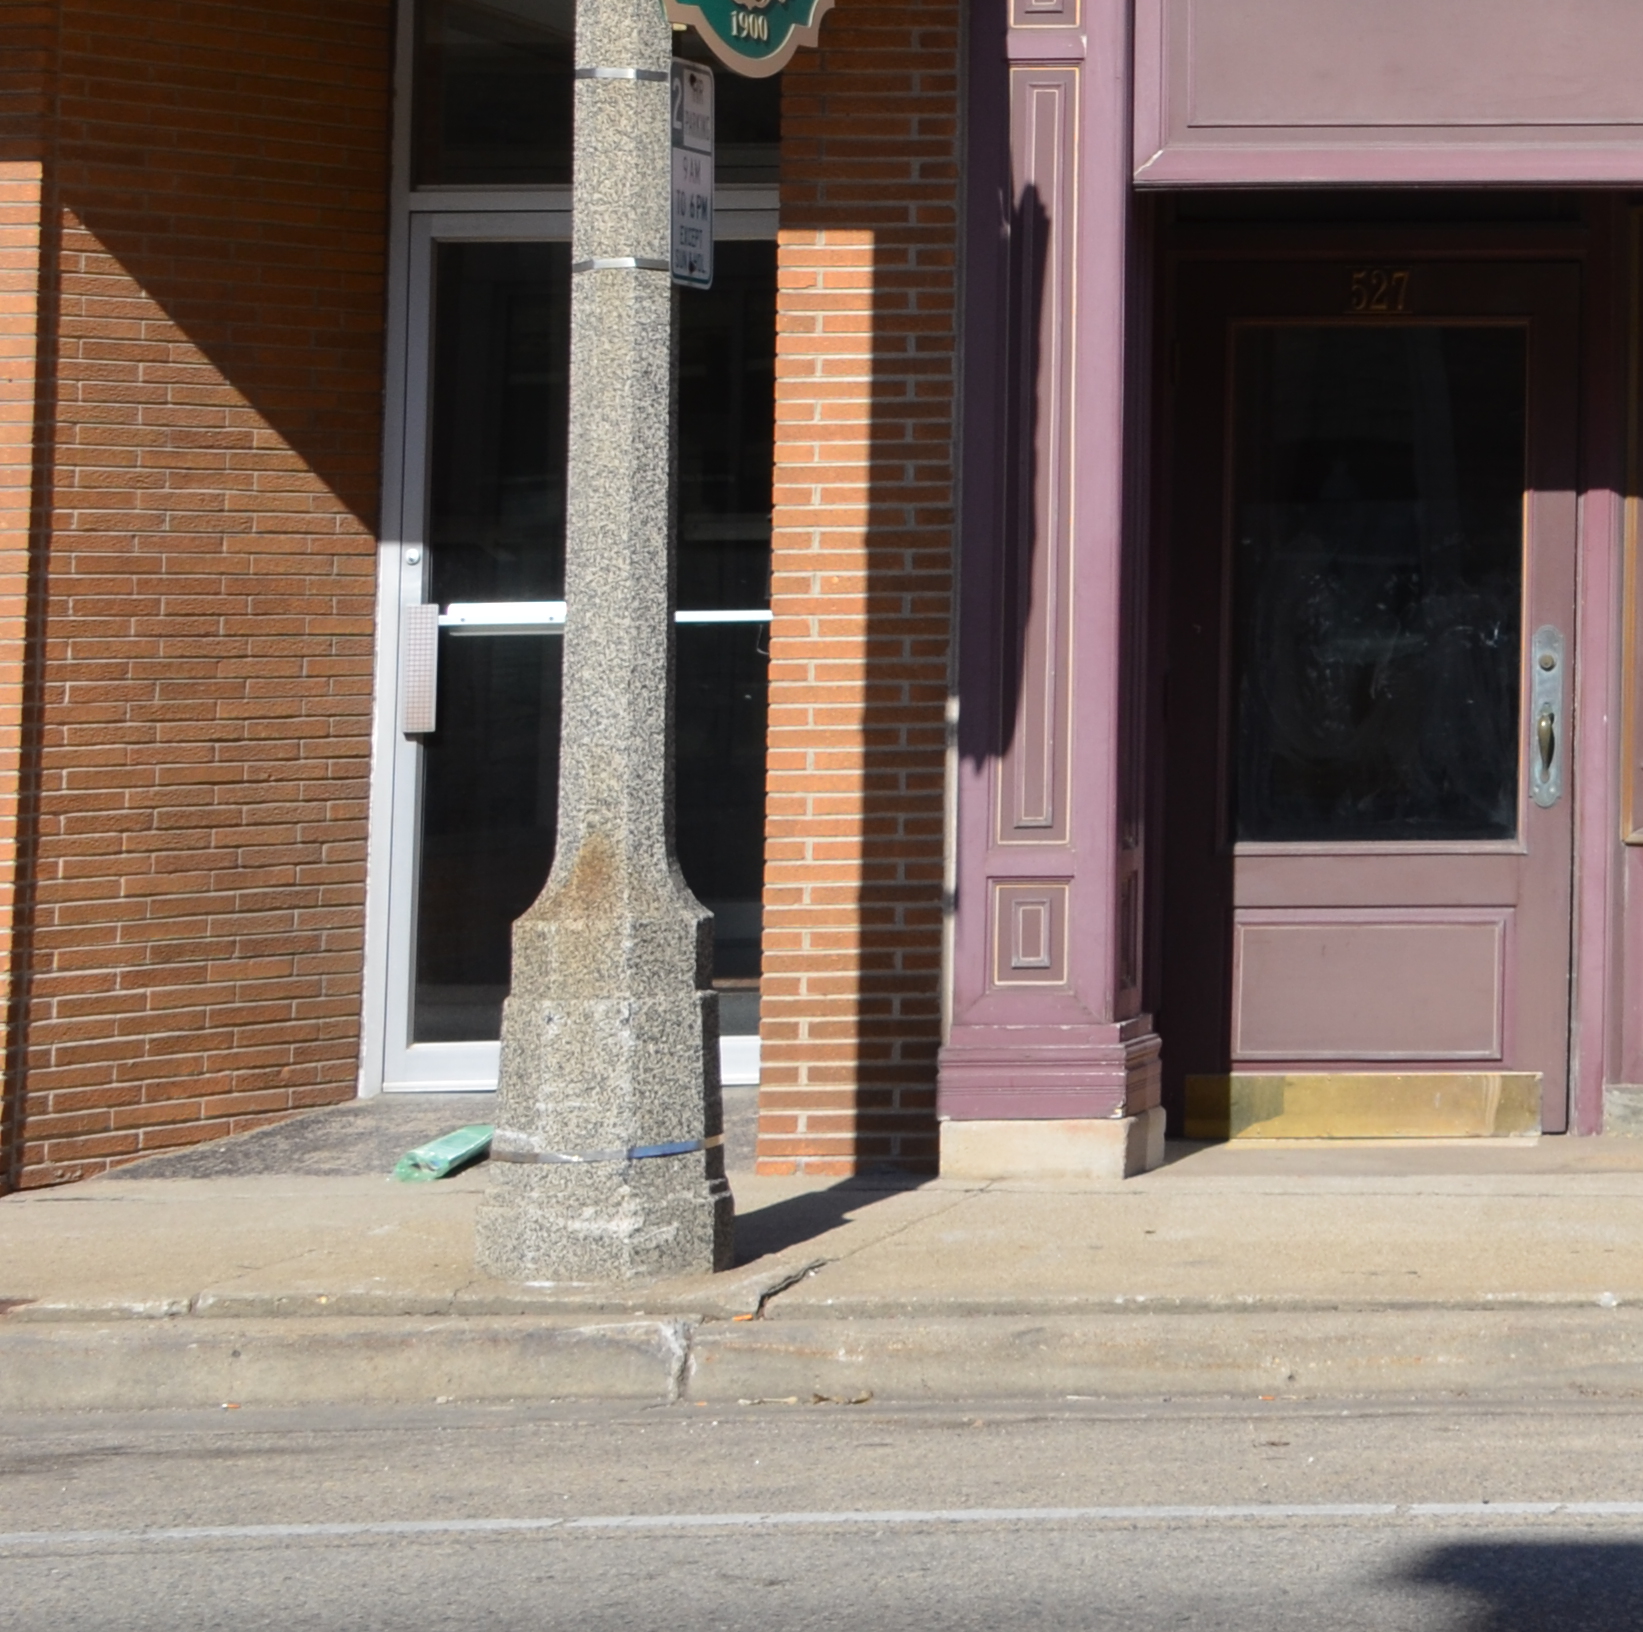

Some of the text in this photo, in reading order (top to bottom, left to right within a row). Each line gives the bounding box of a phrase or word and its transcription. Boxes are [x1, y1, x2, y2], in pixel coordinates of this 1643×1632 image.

[730, 10, 769, 41] 1900
[672, 76, 683, 129] 2
[676, 189, 686, 216] TO
[1351, 269, 1410, 311] 527
